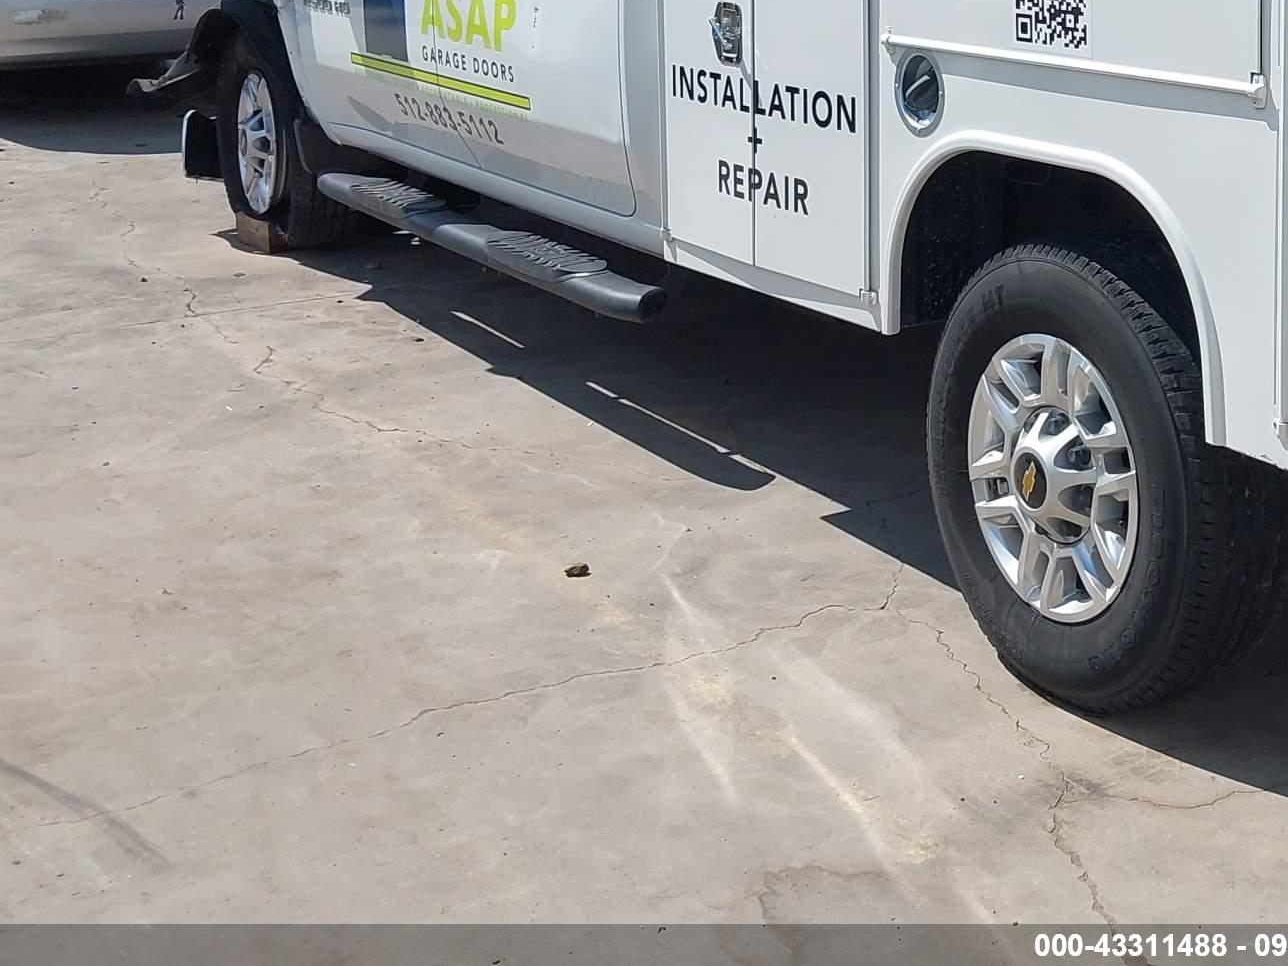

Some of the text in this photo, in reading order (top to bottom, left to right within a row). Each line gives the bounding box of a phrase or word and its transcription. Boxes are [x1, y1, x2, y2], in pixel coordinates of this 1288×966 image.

[422, 45, 515, 83] GARAGE DOORS
[394, 92, 505, 145] 512-883-5112
[672, 64, 856, 134] INSTALLATION
[747, 127, 763, 154] +
[718, 159, 809, 216] REPAIR
